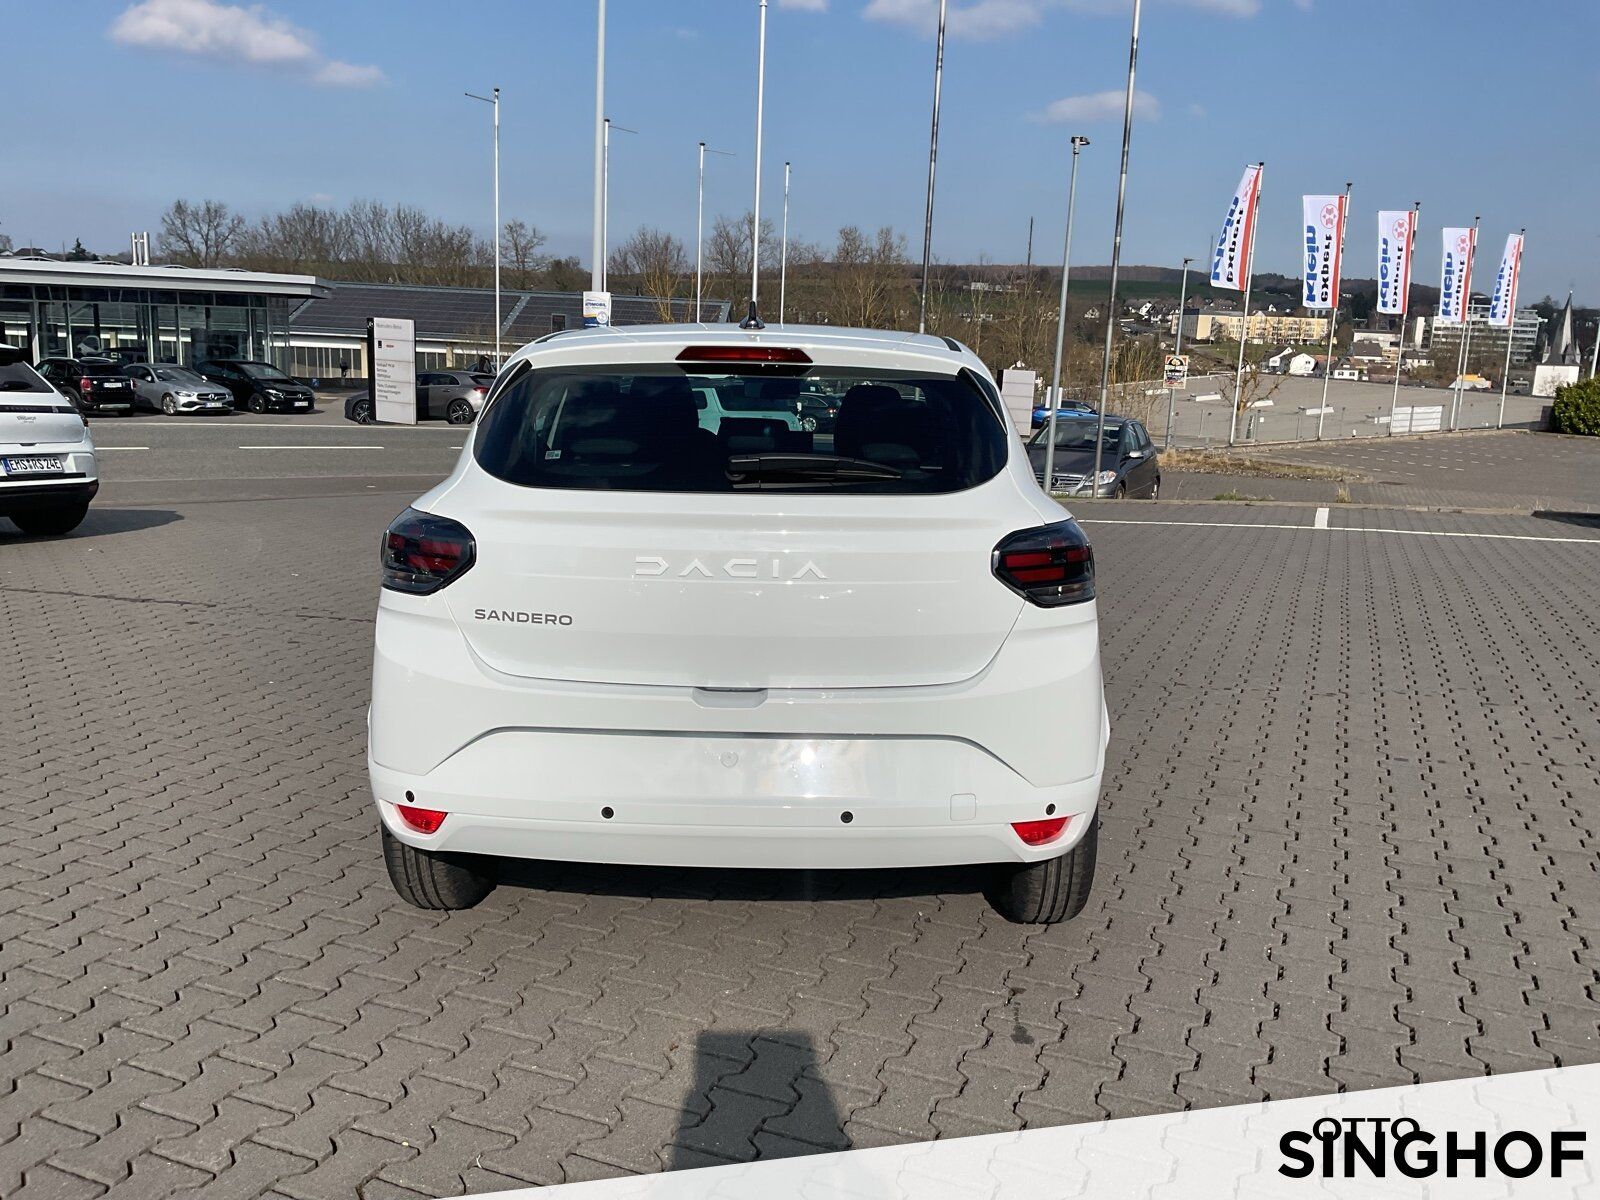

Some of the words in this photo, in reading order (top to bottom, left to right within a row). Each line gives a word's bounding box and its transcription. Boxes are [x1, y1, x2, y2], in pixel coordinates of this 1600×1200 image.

[31, 459, 44, 470] RS
[43, 458, 61, 469] 24E
[634, 556, 828, 579] DACIA
[474, 608, 573, 626] SANDERO
